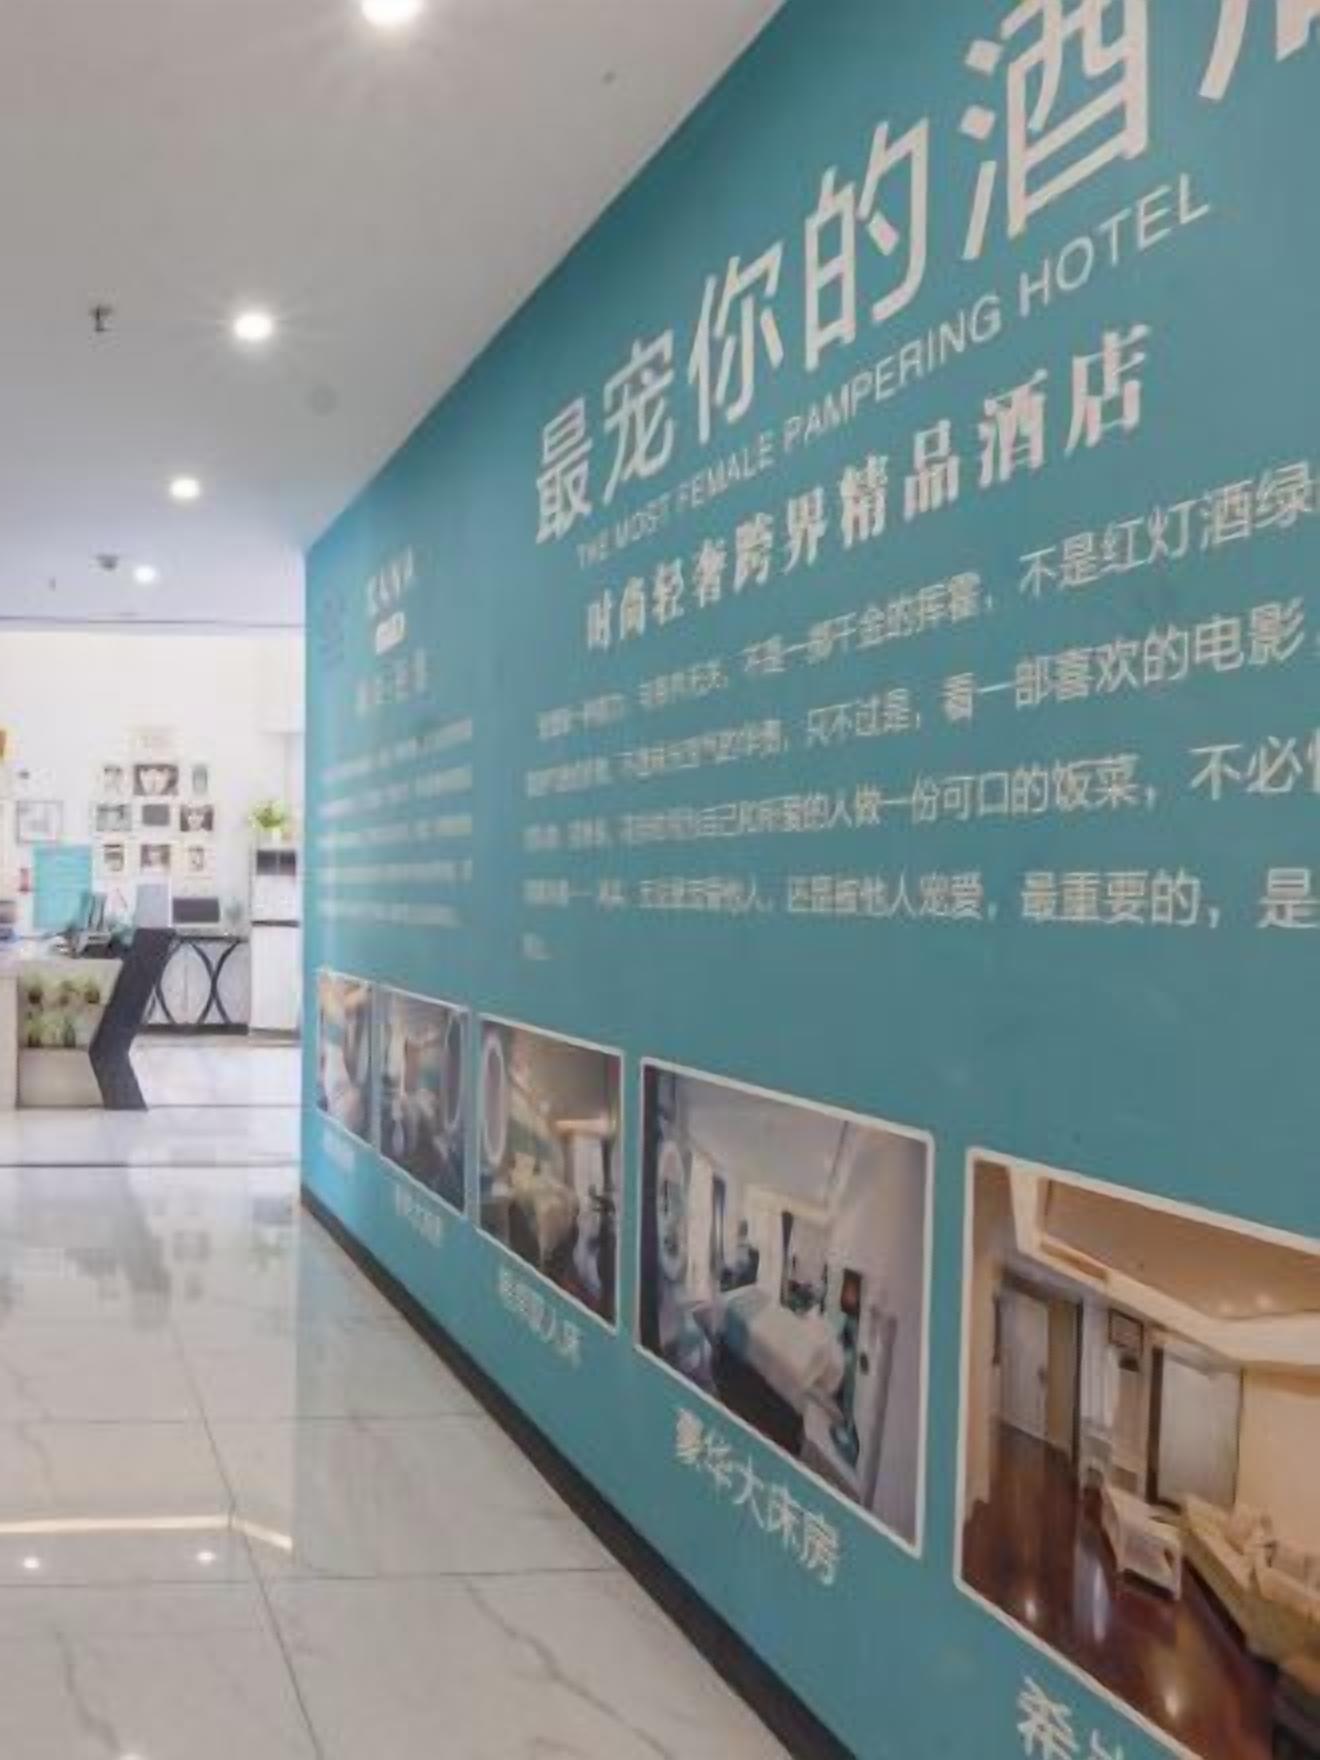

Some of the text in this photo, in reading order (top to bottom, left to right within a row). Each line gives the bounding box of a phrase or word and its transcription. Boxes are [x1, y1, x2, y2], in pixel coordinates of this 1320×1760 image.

[535, 0, 1320, 544] 最宠你的酒
[678, 430, 776, 510] FEMALE
[783, 294, 1002, 454] PAMPERING
[1018, 172, 1212, 319] HOTEL
